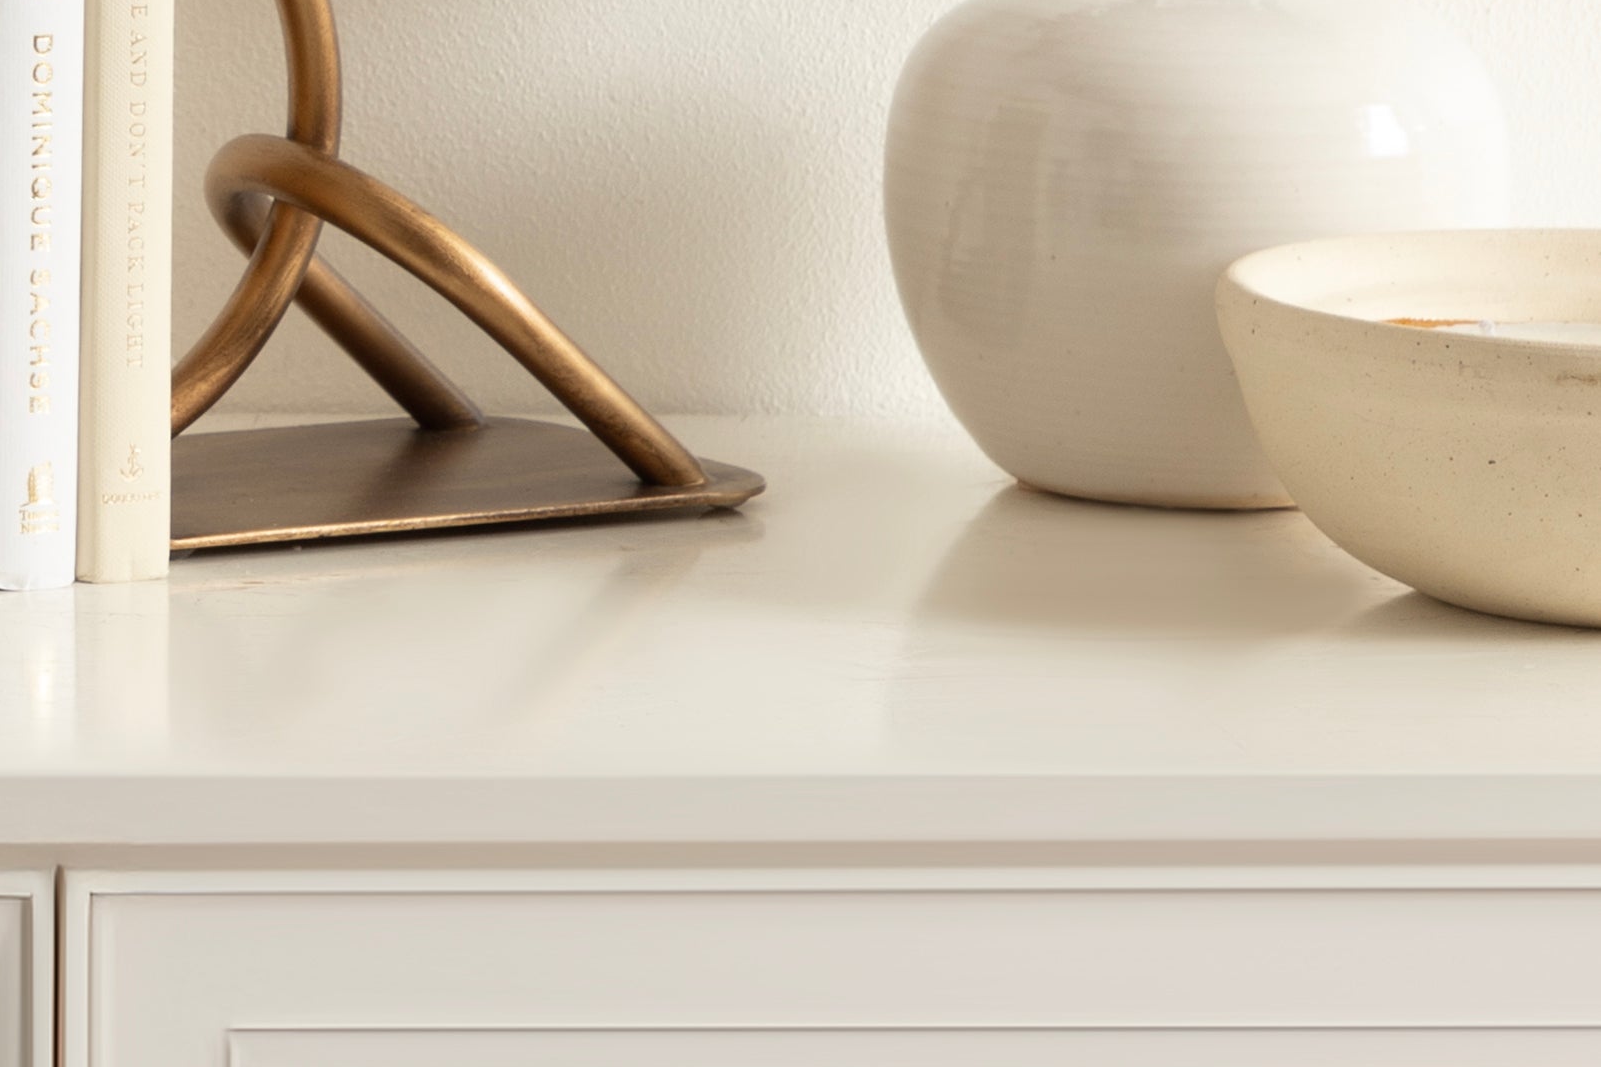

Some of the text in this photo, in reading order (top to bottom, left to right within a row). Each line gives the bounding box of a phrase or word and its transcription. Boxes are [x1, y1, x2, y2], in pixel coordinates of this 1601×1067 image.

[129, 30, 148, 88] AND
[28, 33, 54, 415] DOMINIQUE SACHSE
[127, 201, 146, 272] PACK
[125, 283, 145, 369] LIGHT
